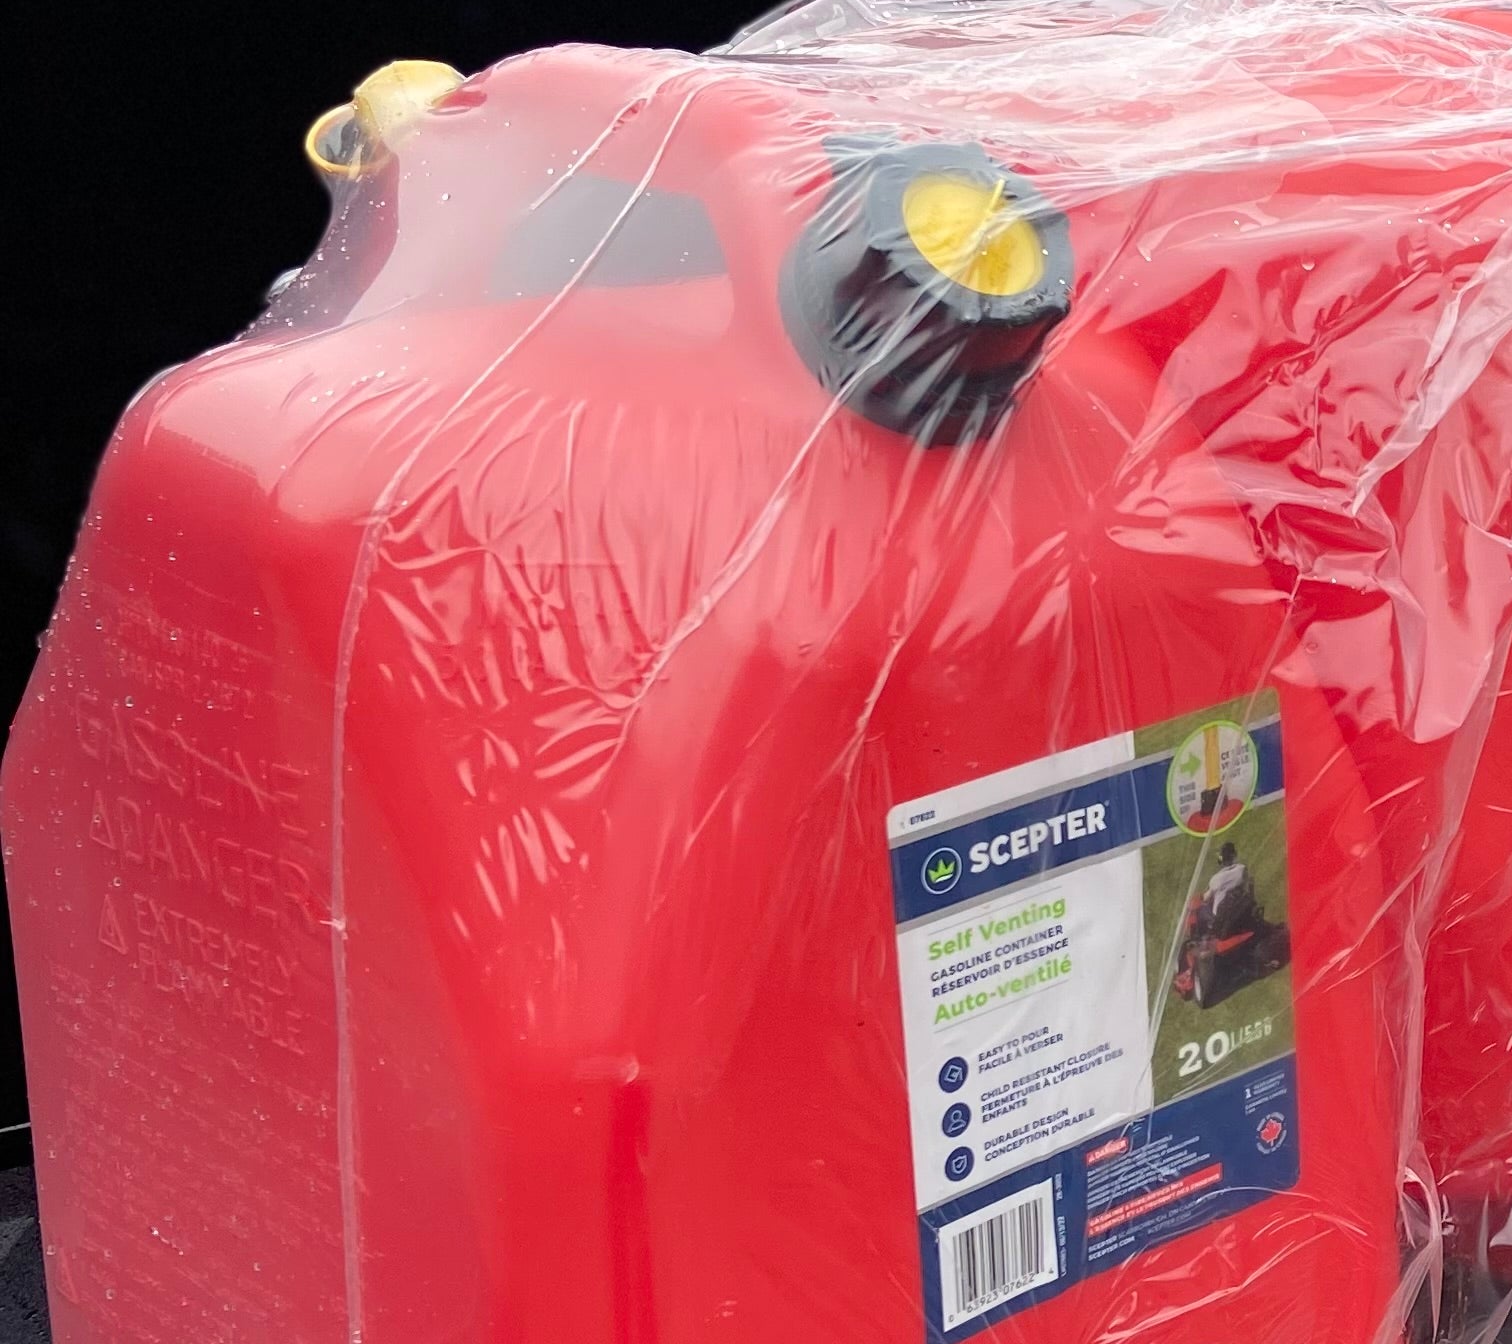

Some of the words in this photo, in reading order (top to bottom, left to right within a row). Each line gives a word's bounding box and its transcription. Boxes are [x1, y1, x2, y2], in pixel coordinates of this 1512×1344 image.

[116, 795, 322, 928] DANGER
[968, 803, 1107, 873] SCEPTER
[928, 928, 972, 961] Self
[979, 898, 1066, 941] Venting
[931, 950, 993, 982] GASOLINE
[995, 924, 1064, 958] CONTAINER
[932, 963, 1001, 998] RÉSERVOIR
[1004, 937, 1070, 970] D'ESSENCE
[934, 953, 1072, 1025] Auto-ventilé
[978, 1043, 1008, 1062] EASY
[1006, 1038, 1019, 1052] TO
[1022, 1026, 1049, 1043] POUR
[978, 1054, 1013, 1074] FACILE
[1024, 1033, 1064, 1055] VERSER
[981, 1084, 1011, 1102] CHILD
[1012, 1060, 1066, 1089] RESISTANT
[1067, 1042, 1112, 1066] CLOSURE
[1178, 1031, 1230, 1077] 20
[982, 1082, 1041, 1113] FERMETURE
[982, 1098, 1028, 1123] ENFANTS
[984, 1125, 1030, 1151] DURABLE
[1032, 1108, 1069, 1130] DESIGN
[985, 1128, 1049, 1162] CONCEPTION
[1052, 1108, 1095, 1134] DURABLE
